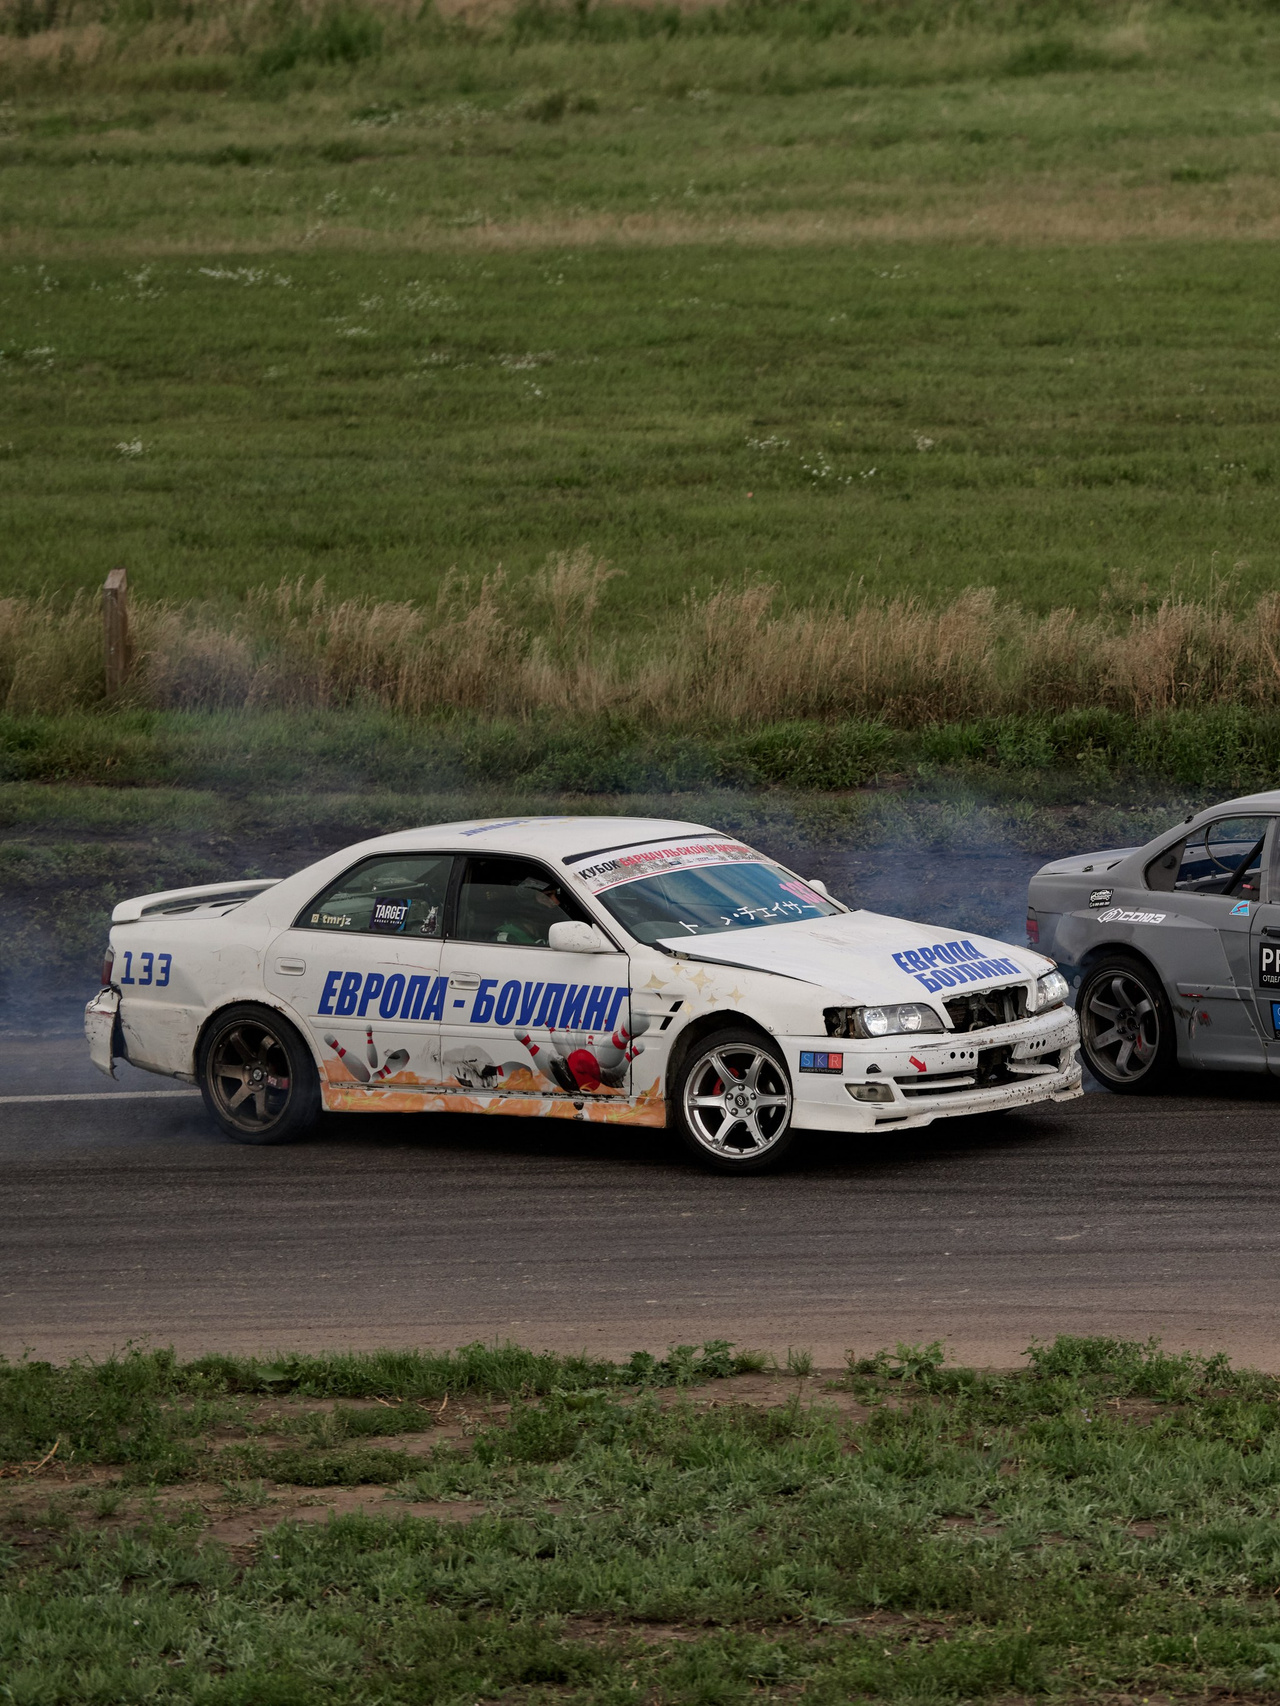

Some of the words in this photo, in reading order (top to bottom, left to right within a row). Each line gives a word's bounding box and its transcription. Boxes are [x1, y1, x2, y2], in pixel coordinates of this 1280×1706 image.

[578, 860, 620, 880] КУБОК
[618, 844, 709, 867] БАРНАУЛЬСКОЙ
[322, 913, 352, 927] tmrjz
[375, 904, 408, 921] TARGET
[121, 951, 172, 987] 133
[891, 940, 988, 974] ЕВРОПА
[913, 958, 1022, 993] БОУЛИНГ
[317, 971, 450, 1021] ЕВРОПА
[470, 979, 634, 1031] БОУЛИНГ
[803, 1053, 839, 1067] SKR
